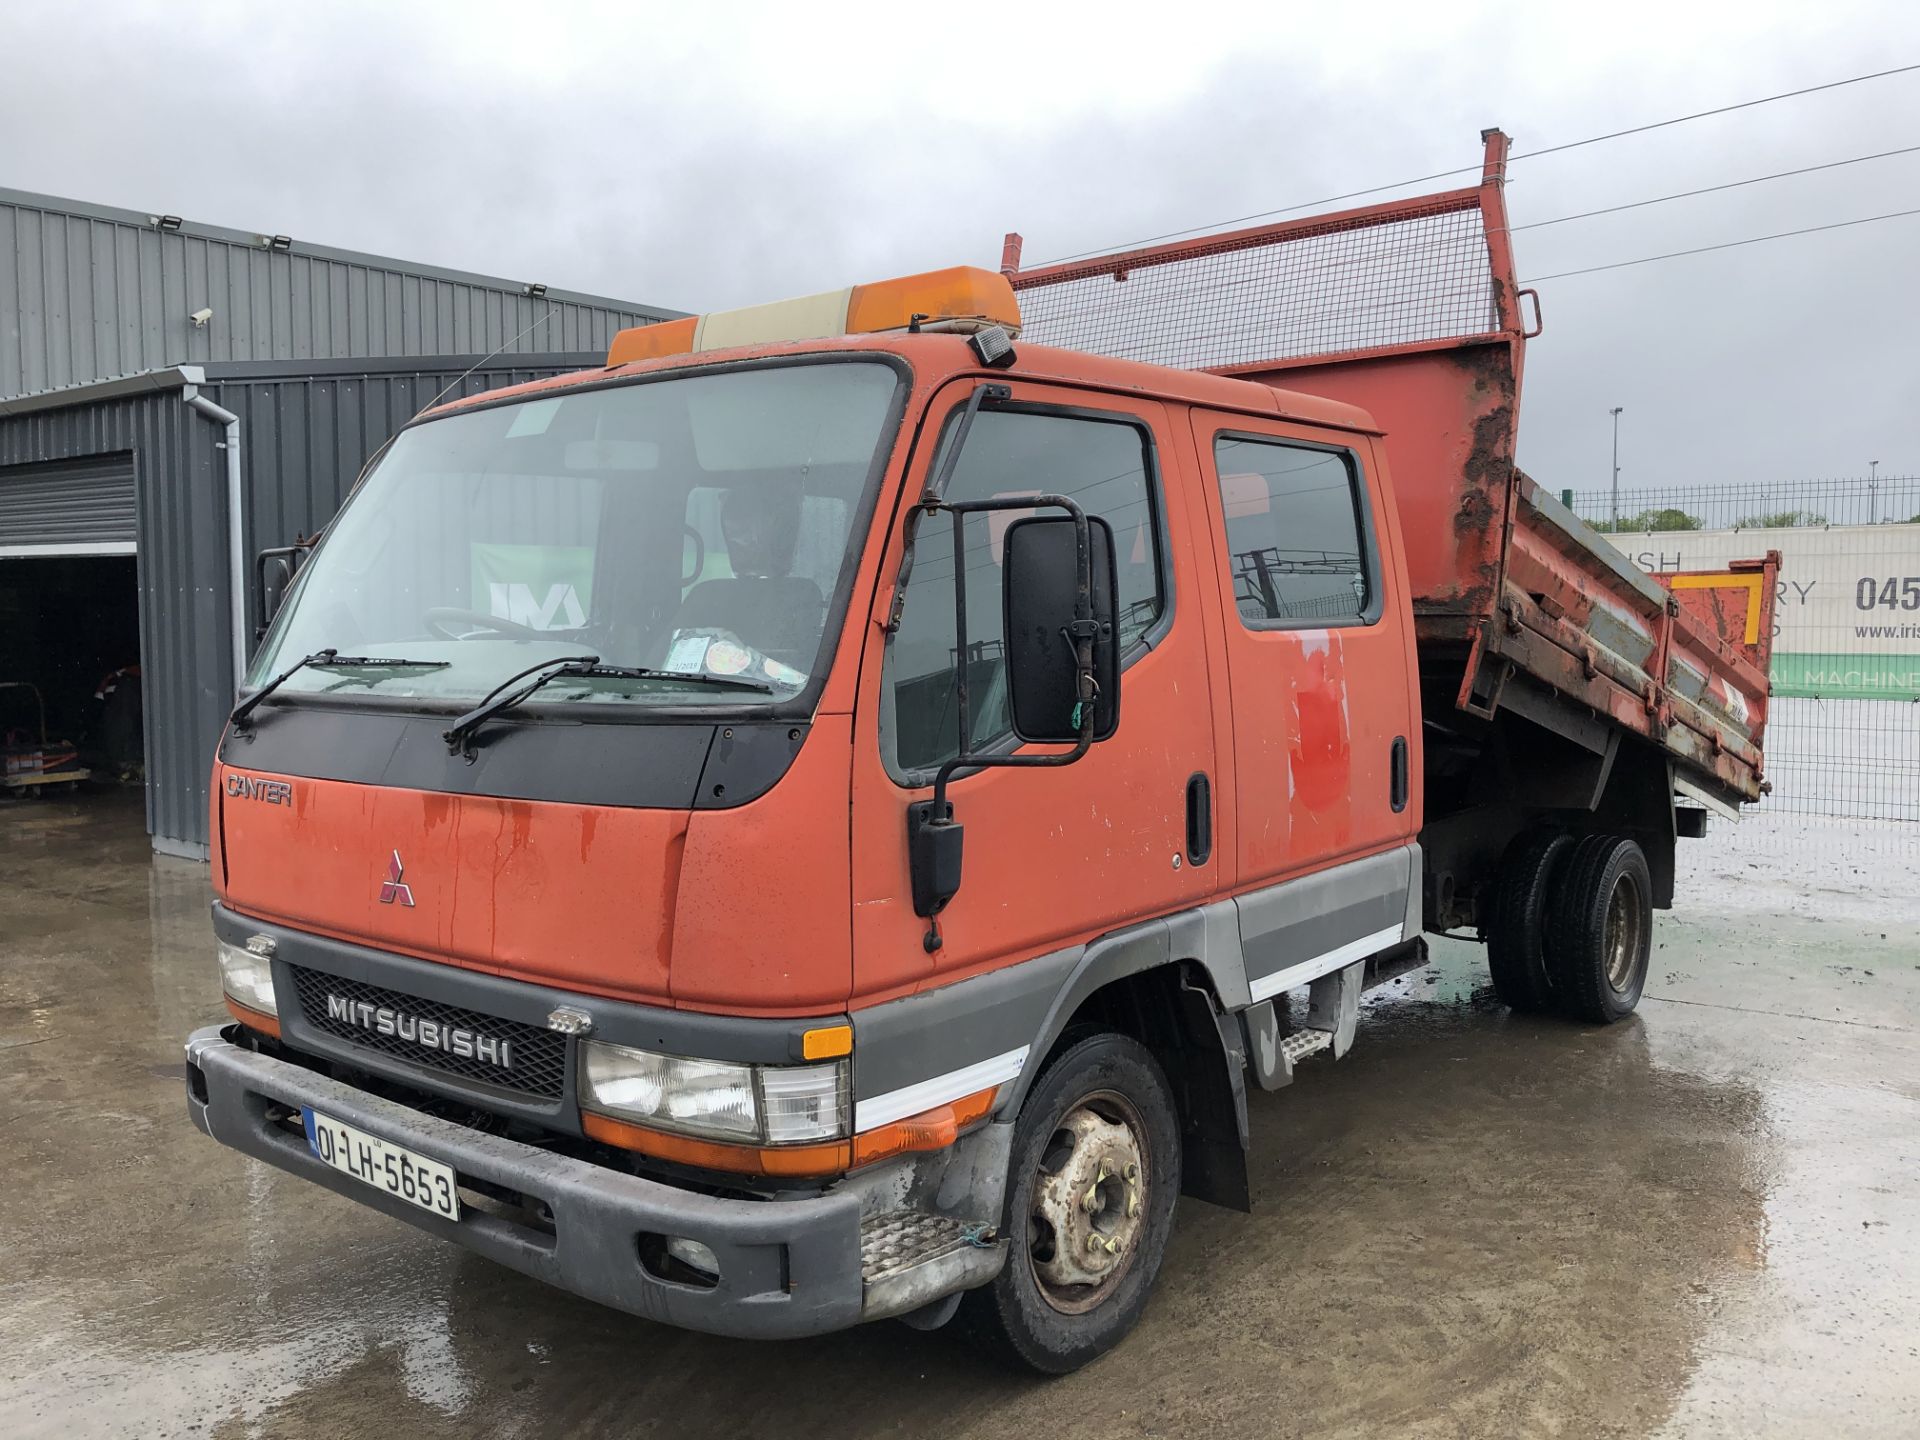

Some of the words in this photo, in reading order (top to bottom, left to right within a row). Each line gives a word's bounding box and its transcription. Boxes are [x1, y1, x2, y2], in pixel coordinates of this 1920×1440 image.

[227, 774, 292, 807] CANTER
[327, 993, 511, 1068] MITSUBISHI
[317, 1124, 452, 1214] 01-LH-5653
